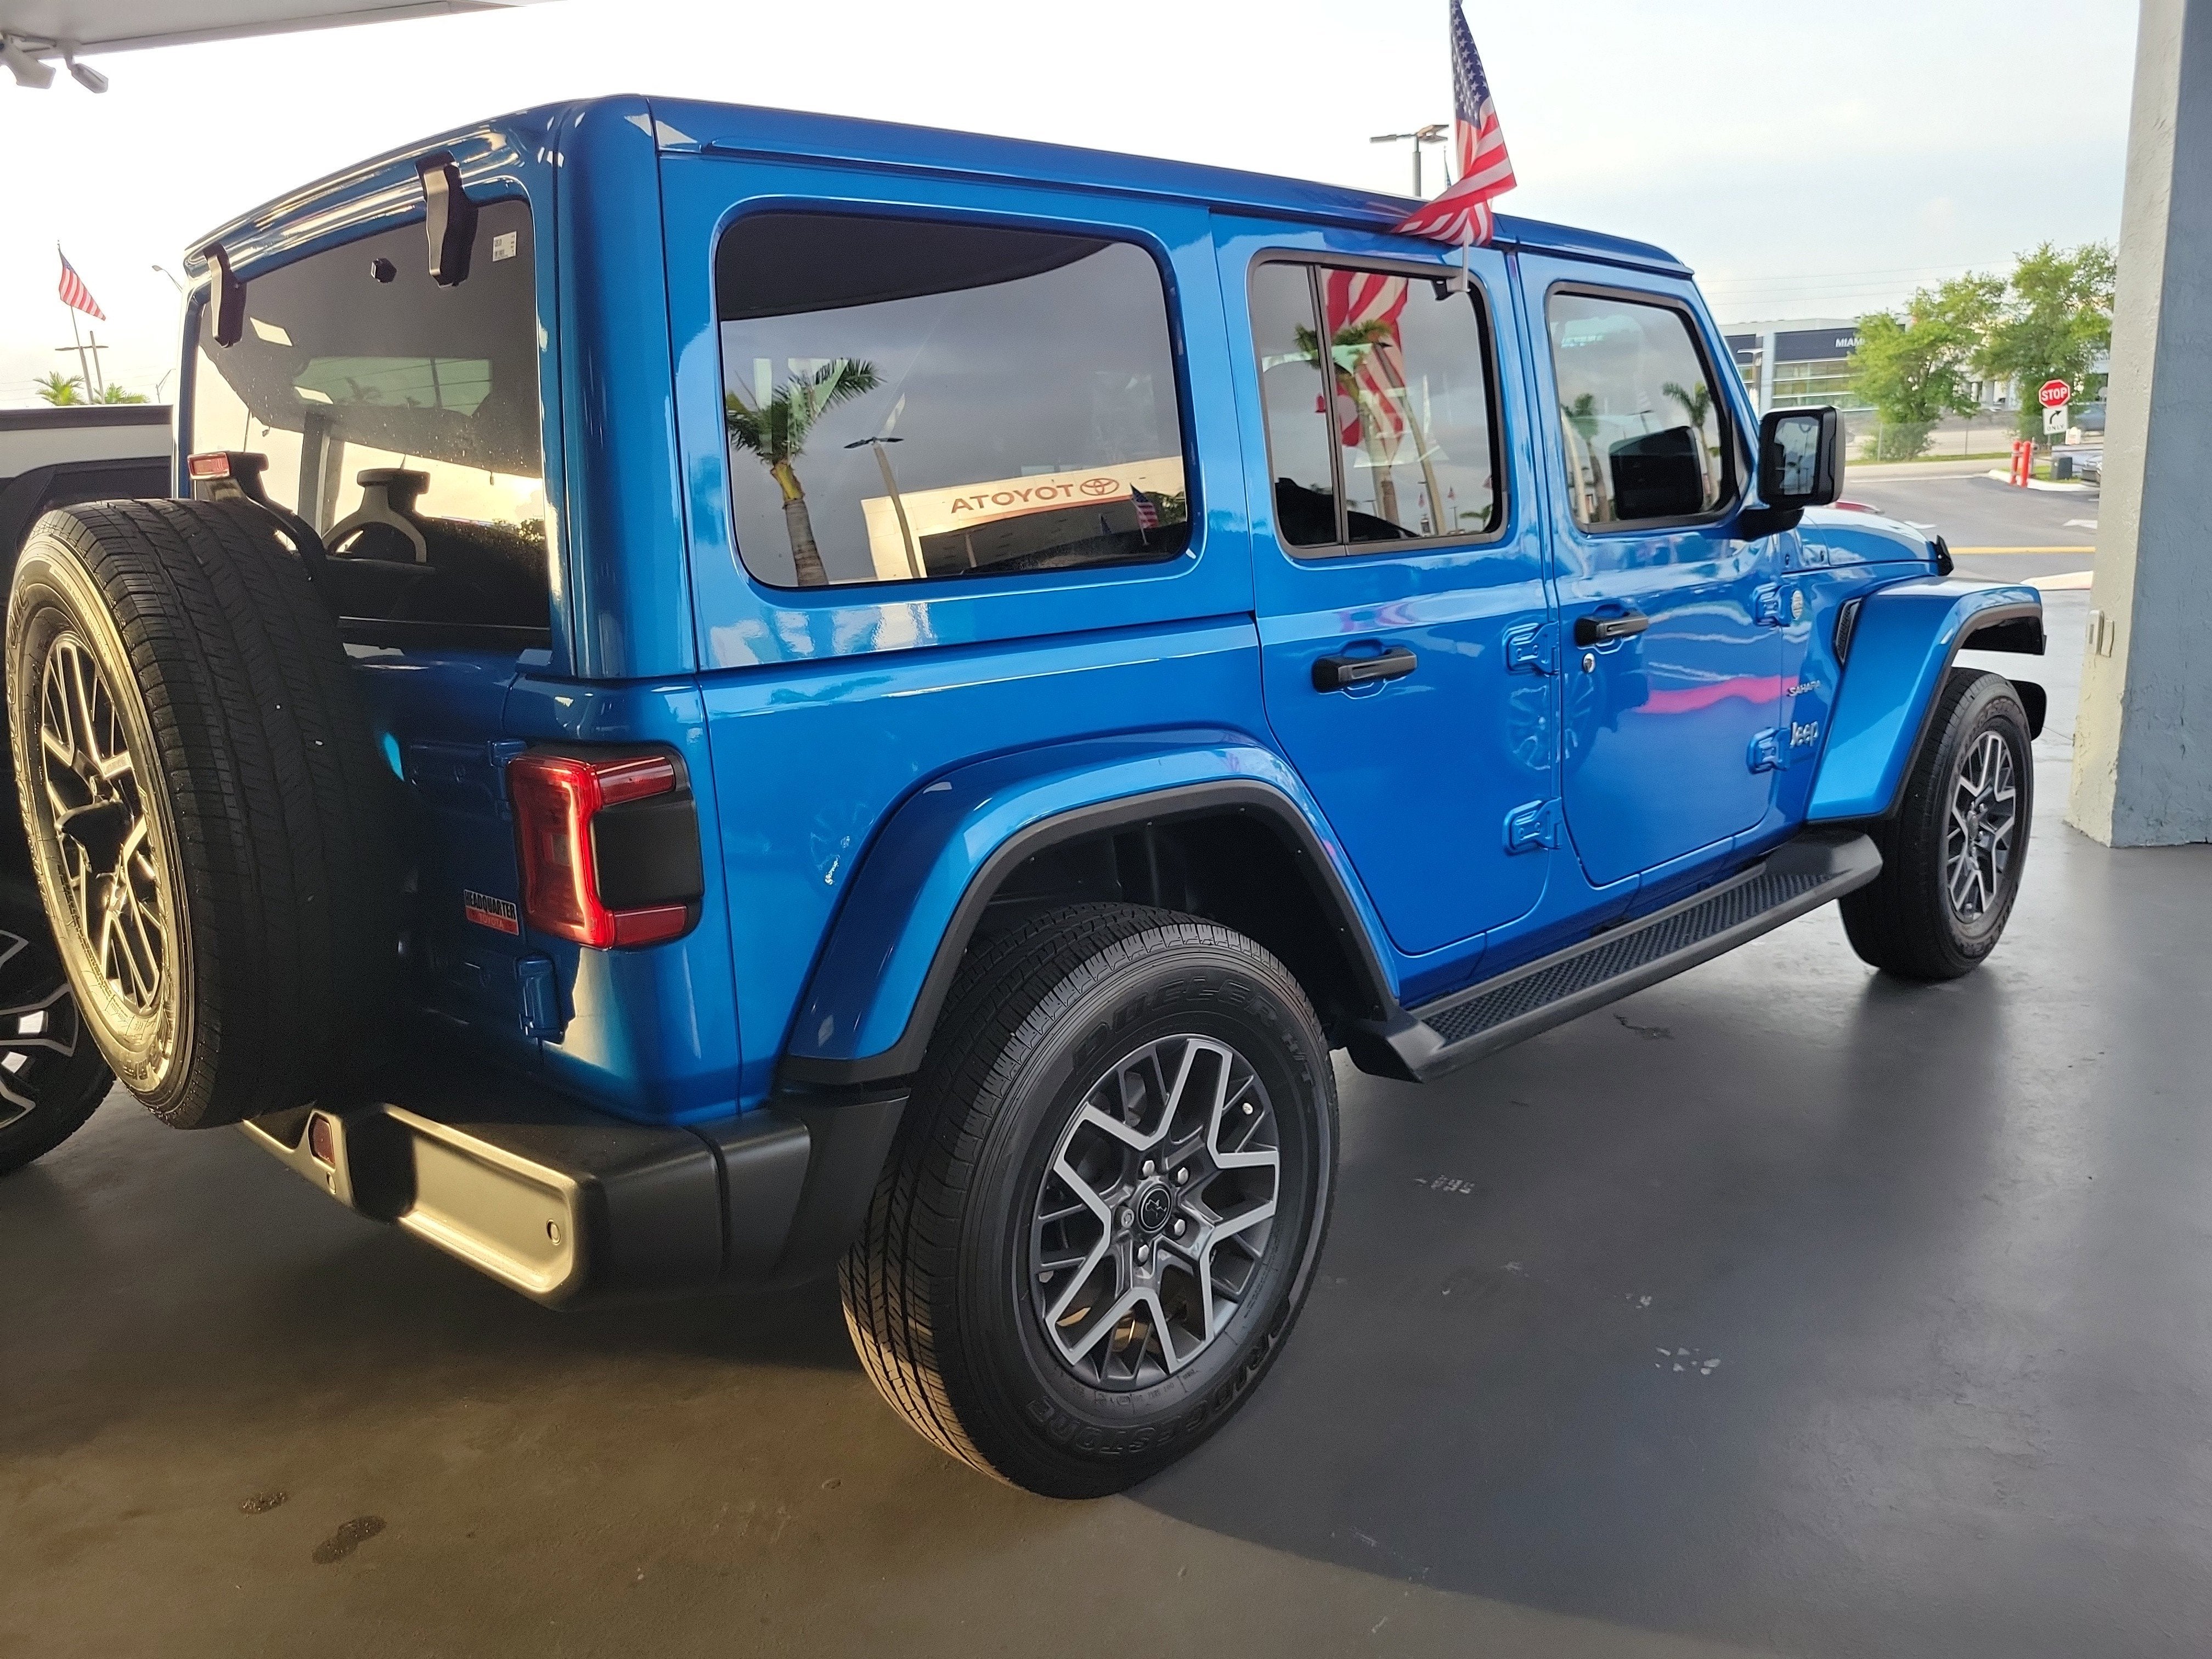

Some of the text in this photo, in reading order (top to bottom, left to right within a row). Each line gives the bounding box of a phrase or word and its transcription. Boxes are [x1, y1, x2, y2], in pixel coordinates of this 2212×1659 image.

[2041, 387, 2068, 401] STOP
[1790, 721, 1819, 748] Jeep
[465, 890, 516, 921] HEADQUARTER
[1073, 975, 1278, 1074] DUELER
